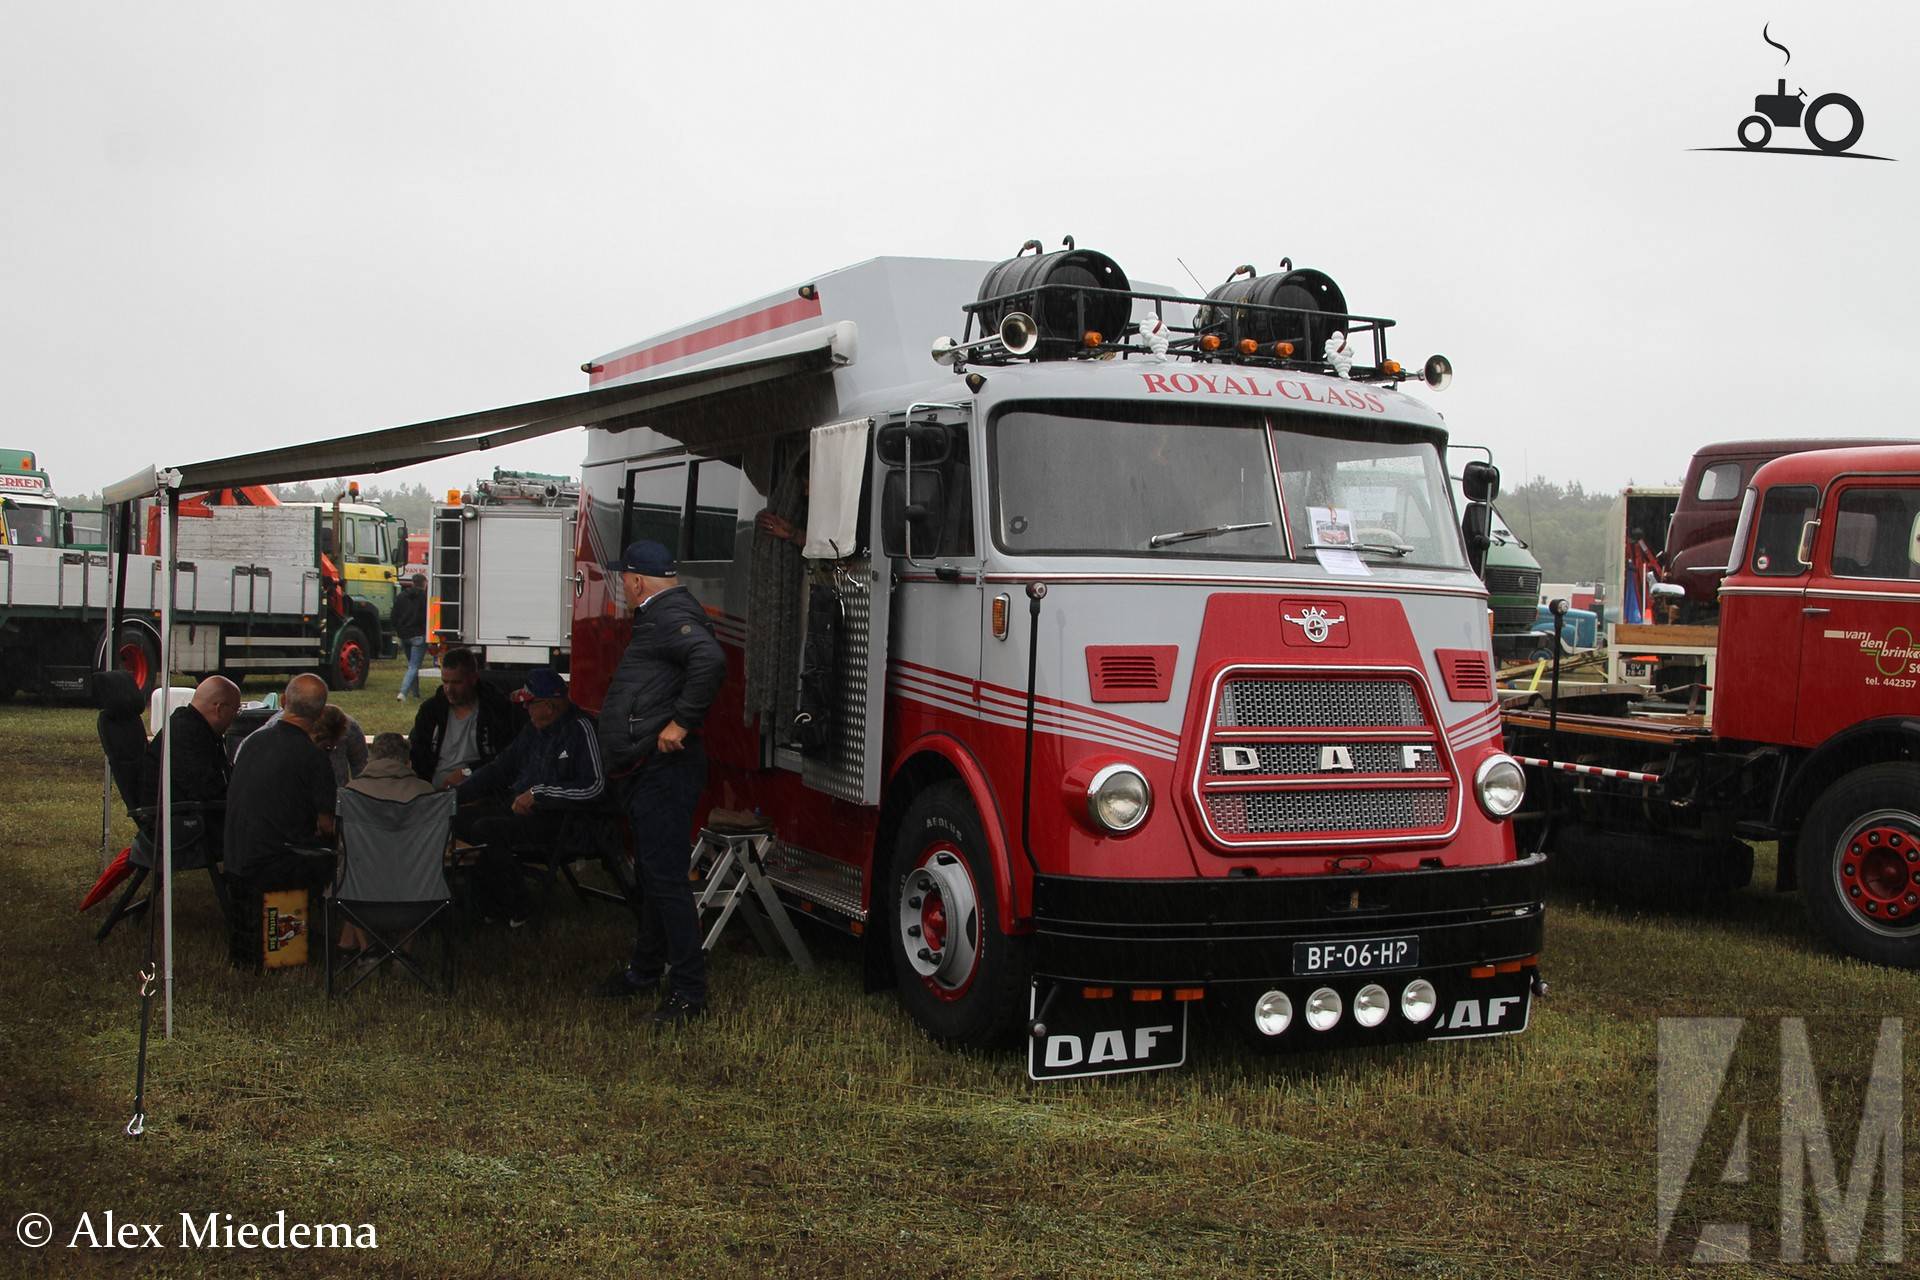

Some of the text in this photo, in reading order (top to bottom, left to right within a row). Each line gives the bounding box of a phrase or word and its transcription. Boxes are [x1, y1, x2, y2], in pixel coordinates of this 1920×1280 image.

[1142, 373, 1385, 414] ROYAL CLASS
[1301, 605, 1328, 618] DAF
[1845, 630, 1867, 640] van
[1860, 632, 1884, 649] den
[1865, 677, 1917, 689] tel. 442357
[926, 816, 962, 841] AEOLUS
[1307, 941, 1408, 970] BF-06-HP
[1434, 996, 1520, 1029] AF
[1045, 1025, 1173, 1067] DAF
